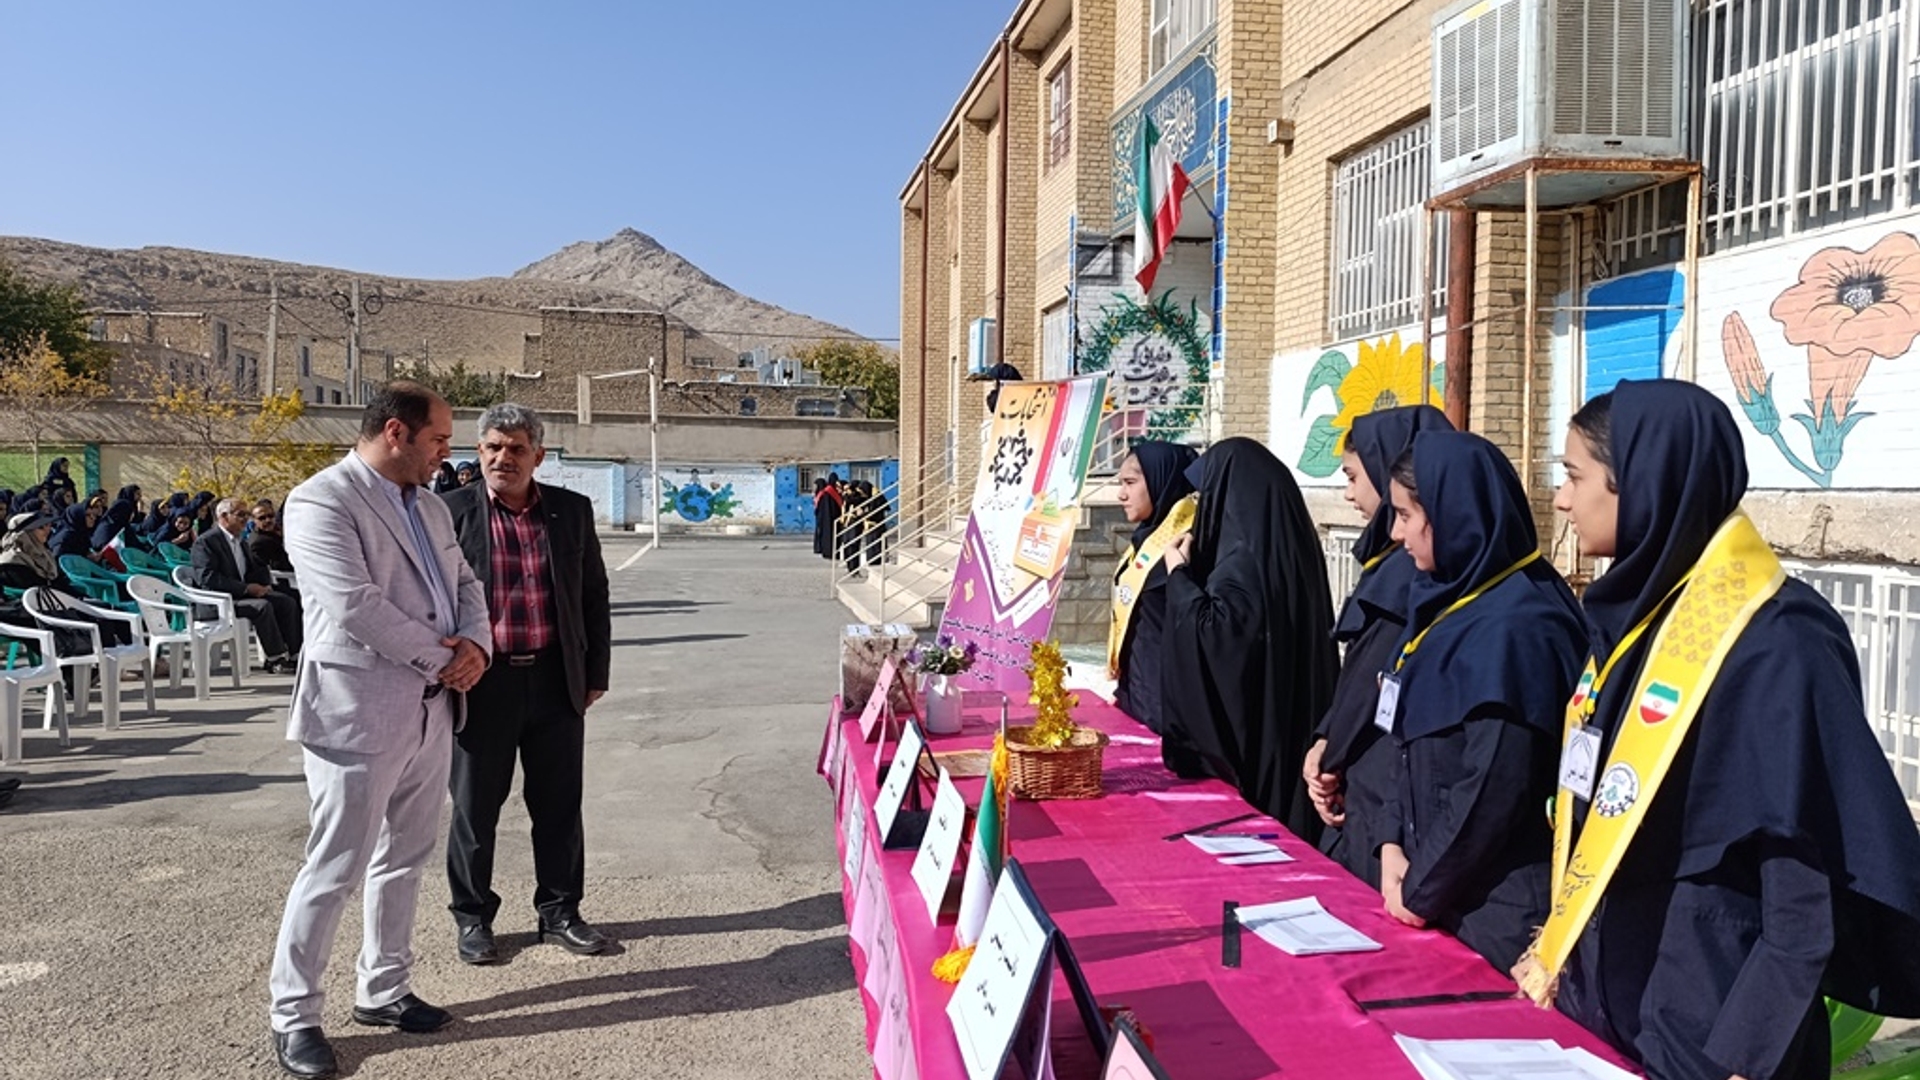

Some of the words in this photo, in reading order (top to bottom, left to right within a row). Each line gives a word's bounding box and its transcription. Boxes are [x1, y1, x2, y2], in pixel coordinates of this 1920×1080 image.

[1127, 335, 1152, 365] که
[1123, 366, 1169, 383] شدت
[1000, 387, 1048, 426] انتخابات
